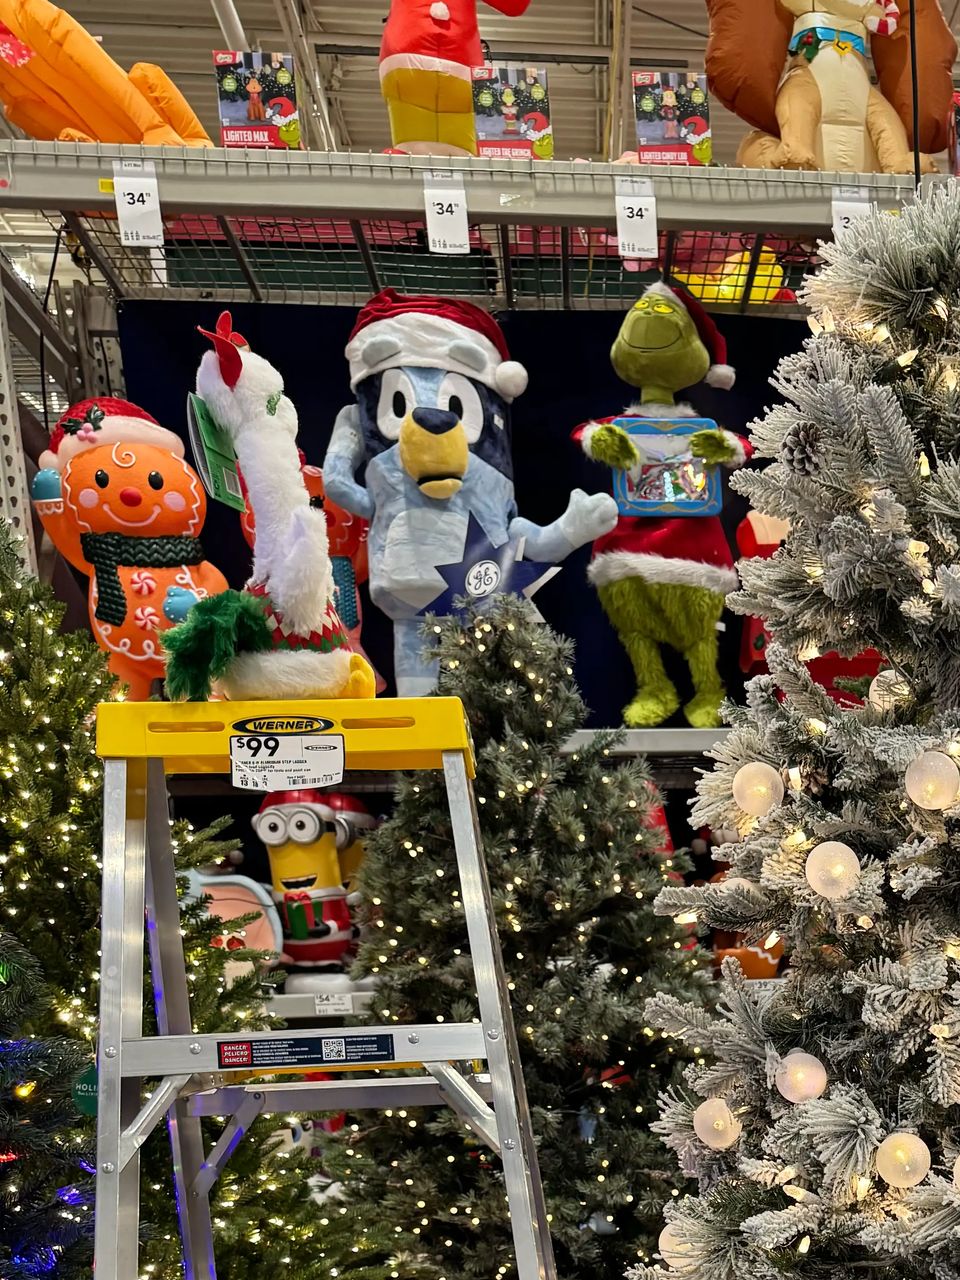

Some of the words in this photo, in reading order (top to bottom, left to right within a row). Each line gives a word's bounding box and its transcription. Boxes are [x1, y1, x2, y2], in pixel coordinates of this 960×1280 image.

[224, 130, 252, 142] LIGHTED
[254, 130, 270, 142] MAX
[480, 147, 500, 156] LIGHTED
[252, 720, 314, 730] WERNER
[236, 736, 280, 758] $99
[76, 1083, 96, 1092] HOLI
